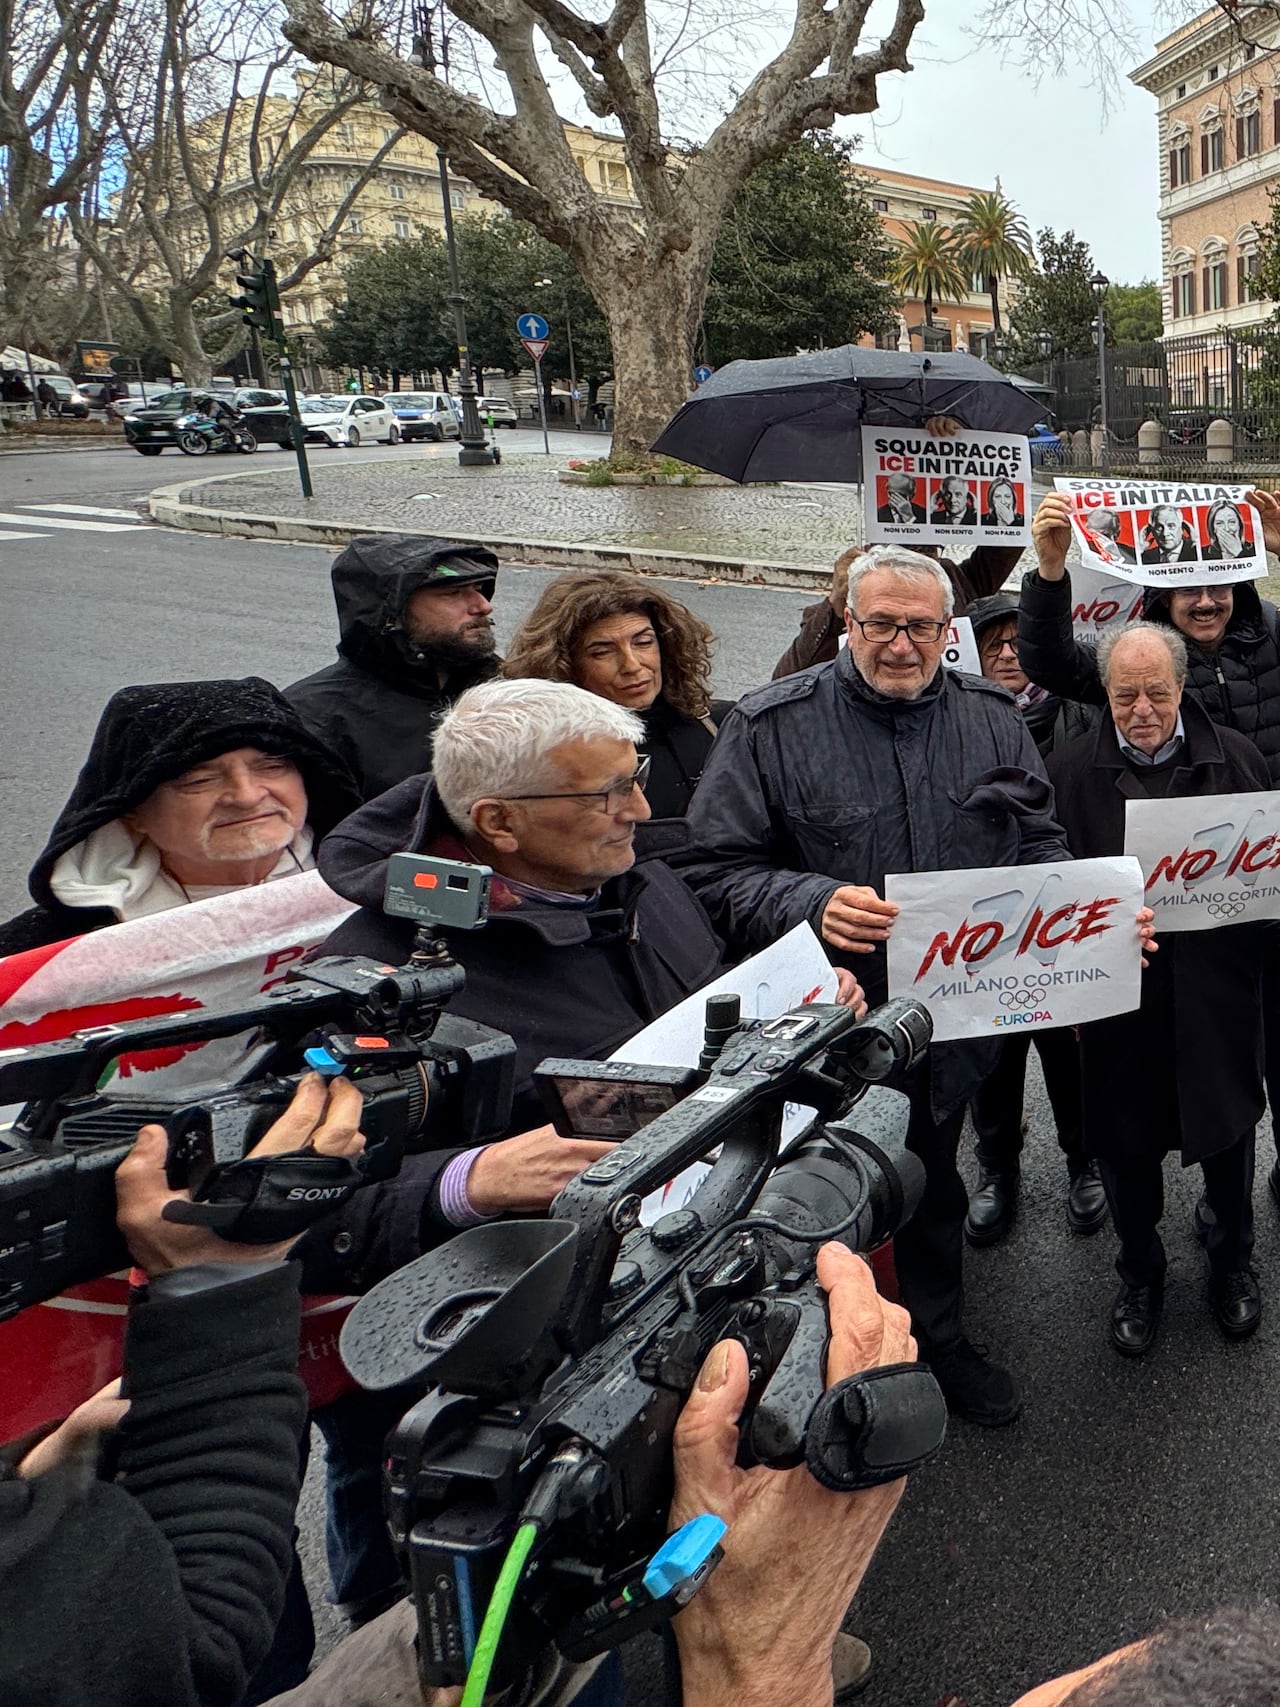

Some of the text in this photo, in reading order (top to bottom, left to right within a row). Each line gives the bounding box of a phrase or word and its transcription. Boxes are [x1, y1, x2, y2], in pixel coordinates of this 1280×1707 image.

[875, 439, 1021, 461] SQUADRACCE
[879, 456, 1019, 478] ICE IN ITALIA?
[1076, 487, 1242, 509] ICE IN ITALIA?
[1149, 566, 1194, 576] NON SENTO
[1208, 562, 1252, 572] NON PARLO
[1072, 597, 1119, 622] NO
[1145, 847, 1215, 892] NO
[1151, 893, 1224, 907] MILANO
[913, 897, 1121, 984] NO ICE
[928, 967, 1111, 999] MILANO CORTINA
[286, 1186, 348, 1201] SONY
